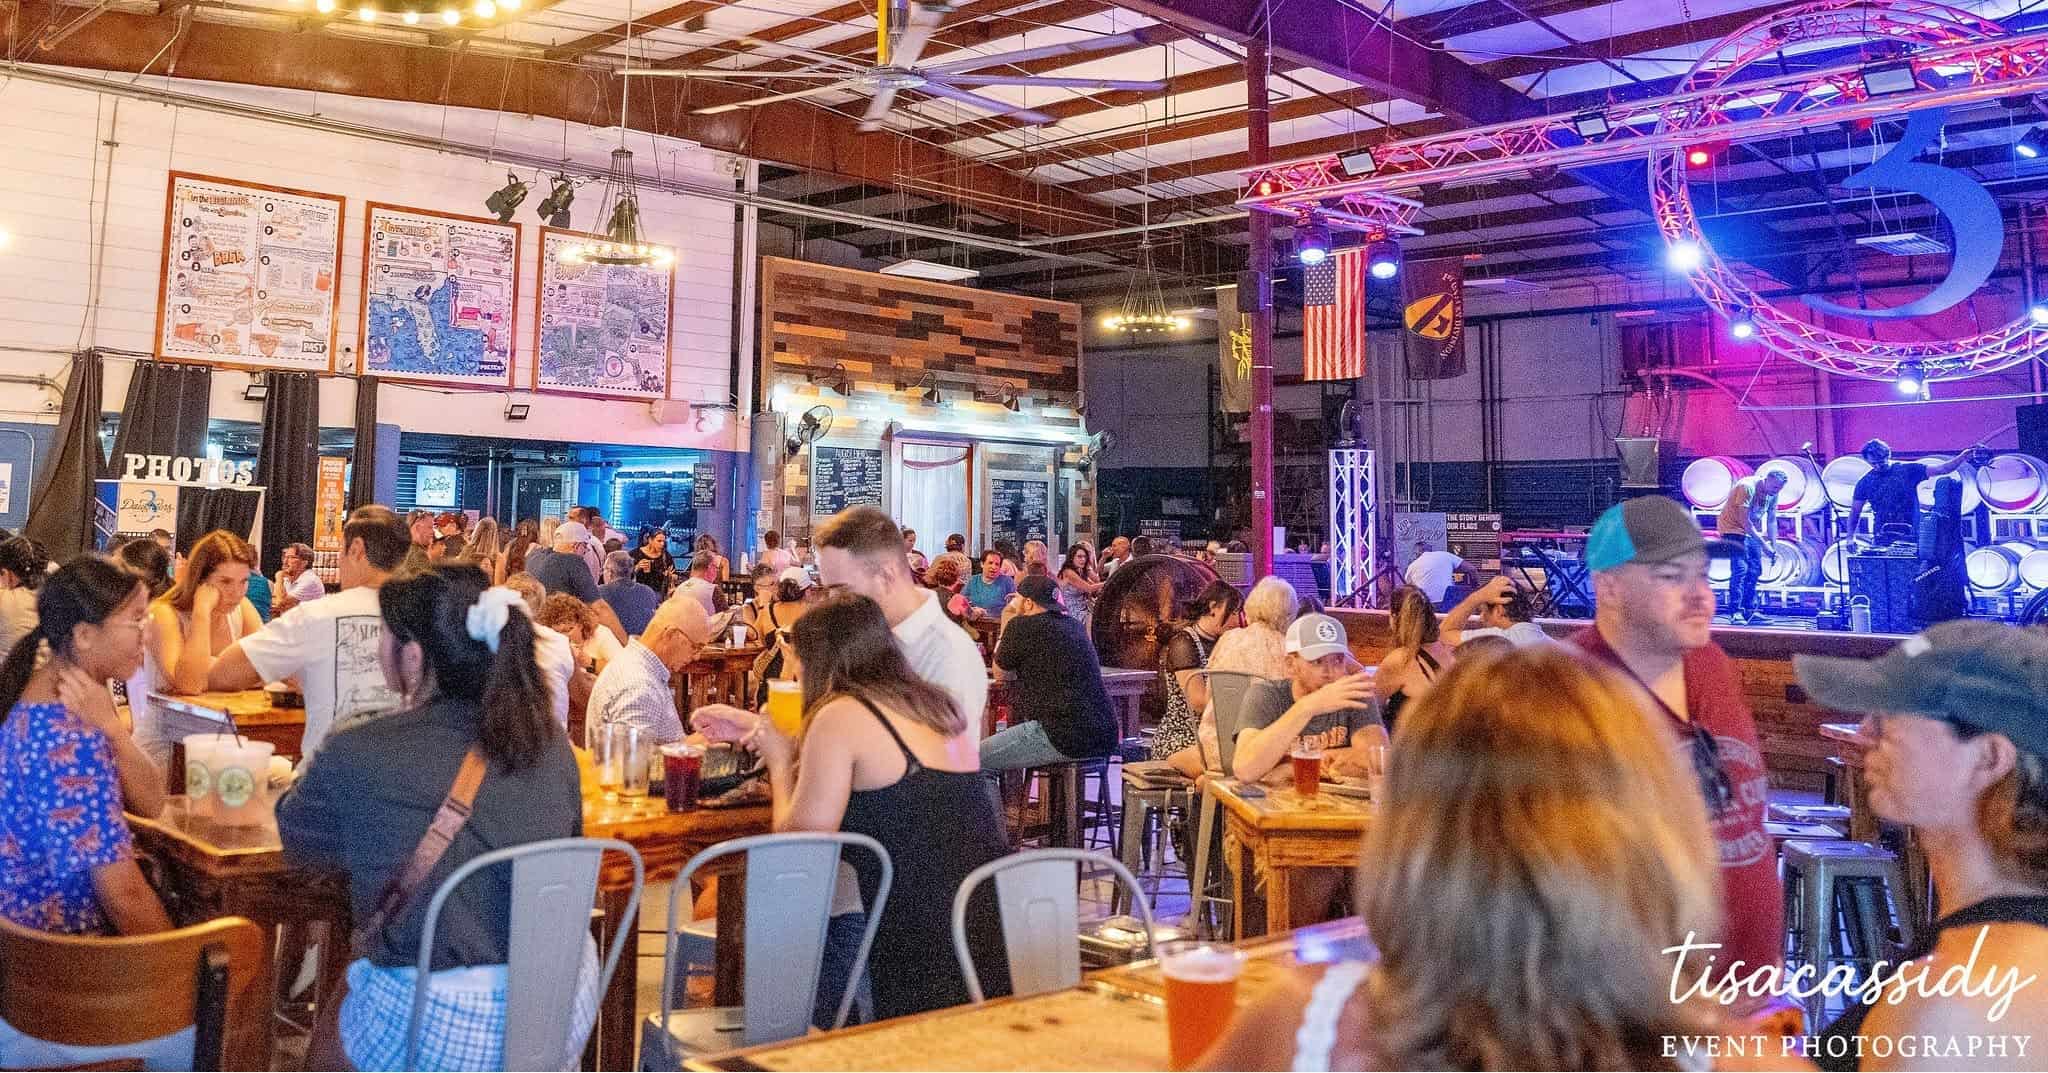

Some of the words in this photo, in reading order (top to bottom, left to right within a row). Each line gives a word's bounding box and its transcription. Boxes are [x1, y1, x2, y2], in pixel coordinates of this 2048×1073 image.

[303, 342, 323, 353] PAST
[121, 453, 253, 487] PHOTOS
[1447, 513, 1458, 521] THE
[1459, 513, 1477, 521] STORY
[1447, 522, 1459, 530] OUR
[1459, 522, 1478, 530] FLAGS
